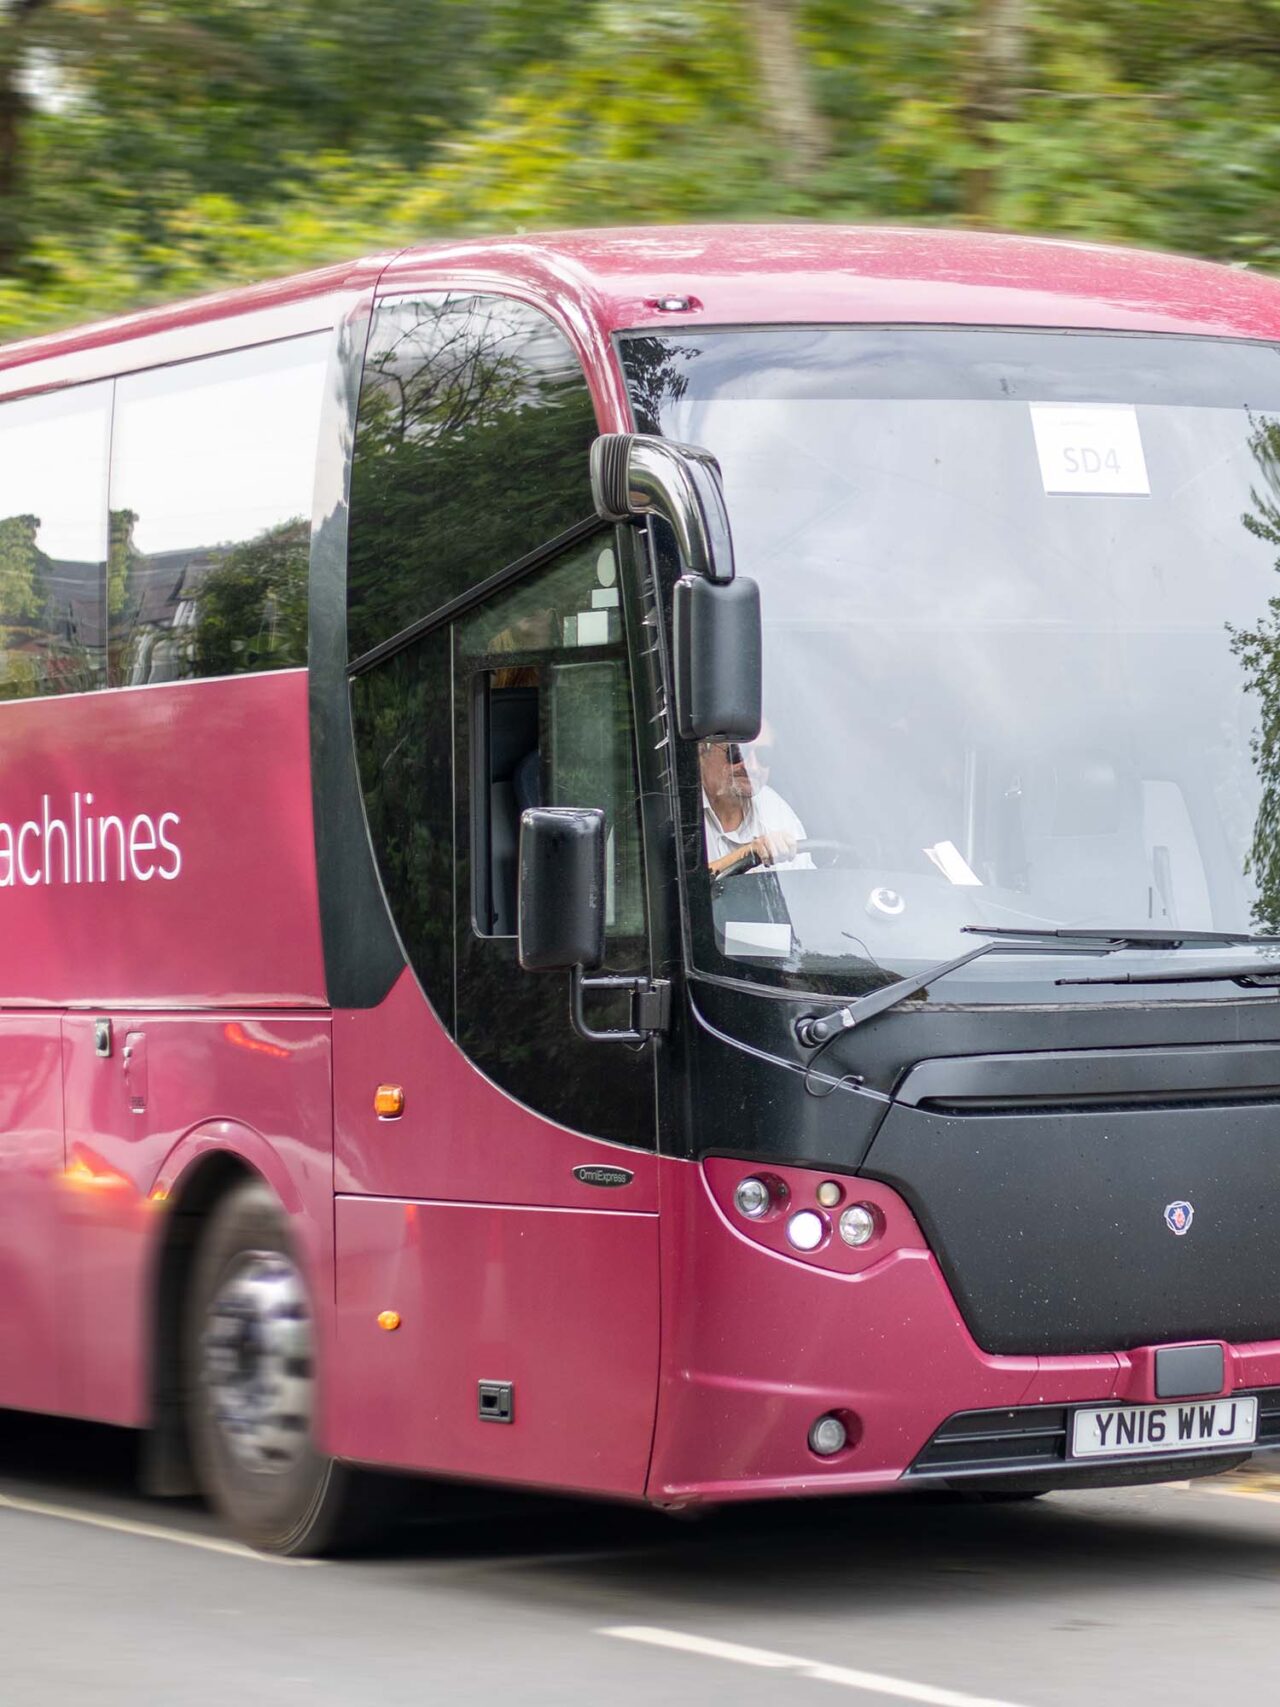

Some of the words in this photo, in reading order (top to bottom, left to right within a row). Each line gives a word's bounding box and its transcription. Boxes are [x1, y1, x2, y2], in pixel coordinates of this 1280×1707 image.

[1063, 447, 1122, 475] SD4
[0, 791, 182, 887] achlines
[579, 1169, 626, 1183] OmniExpress
[1095, 1409, 1167, 1447] YN16
[1177, 1403, 1237, 1441] WWJ
